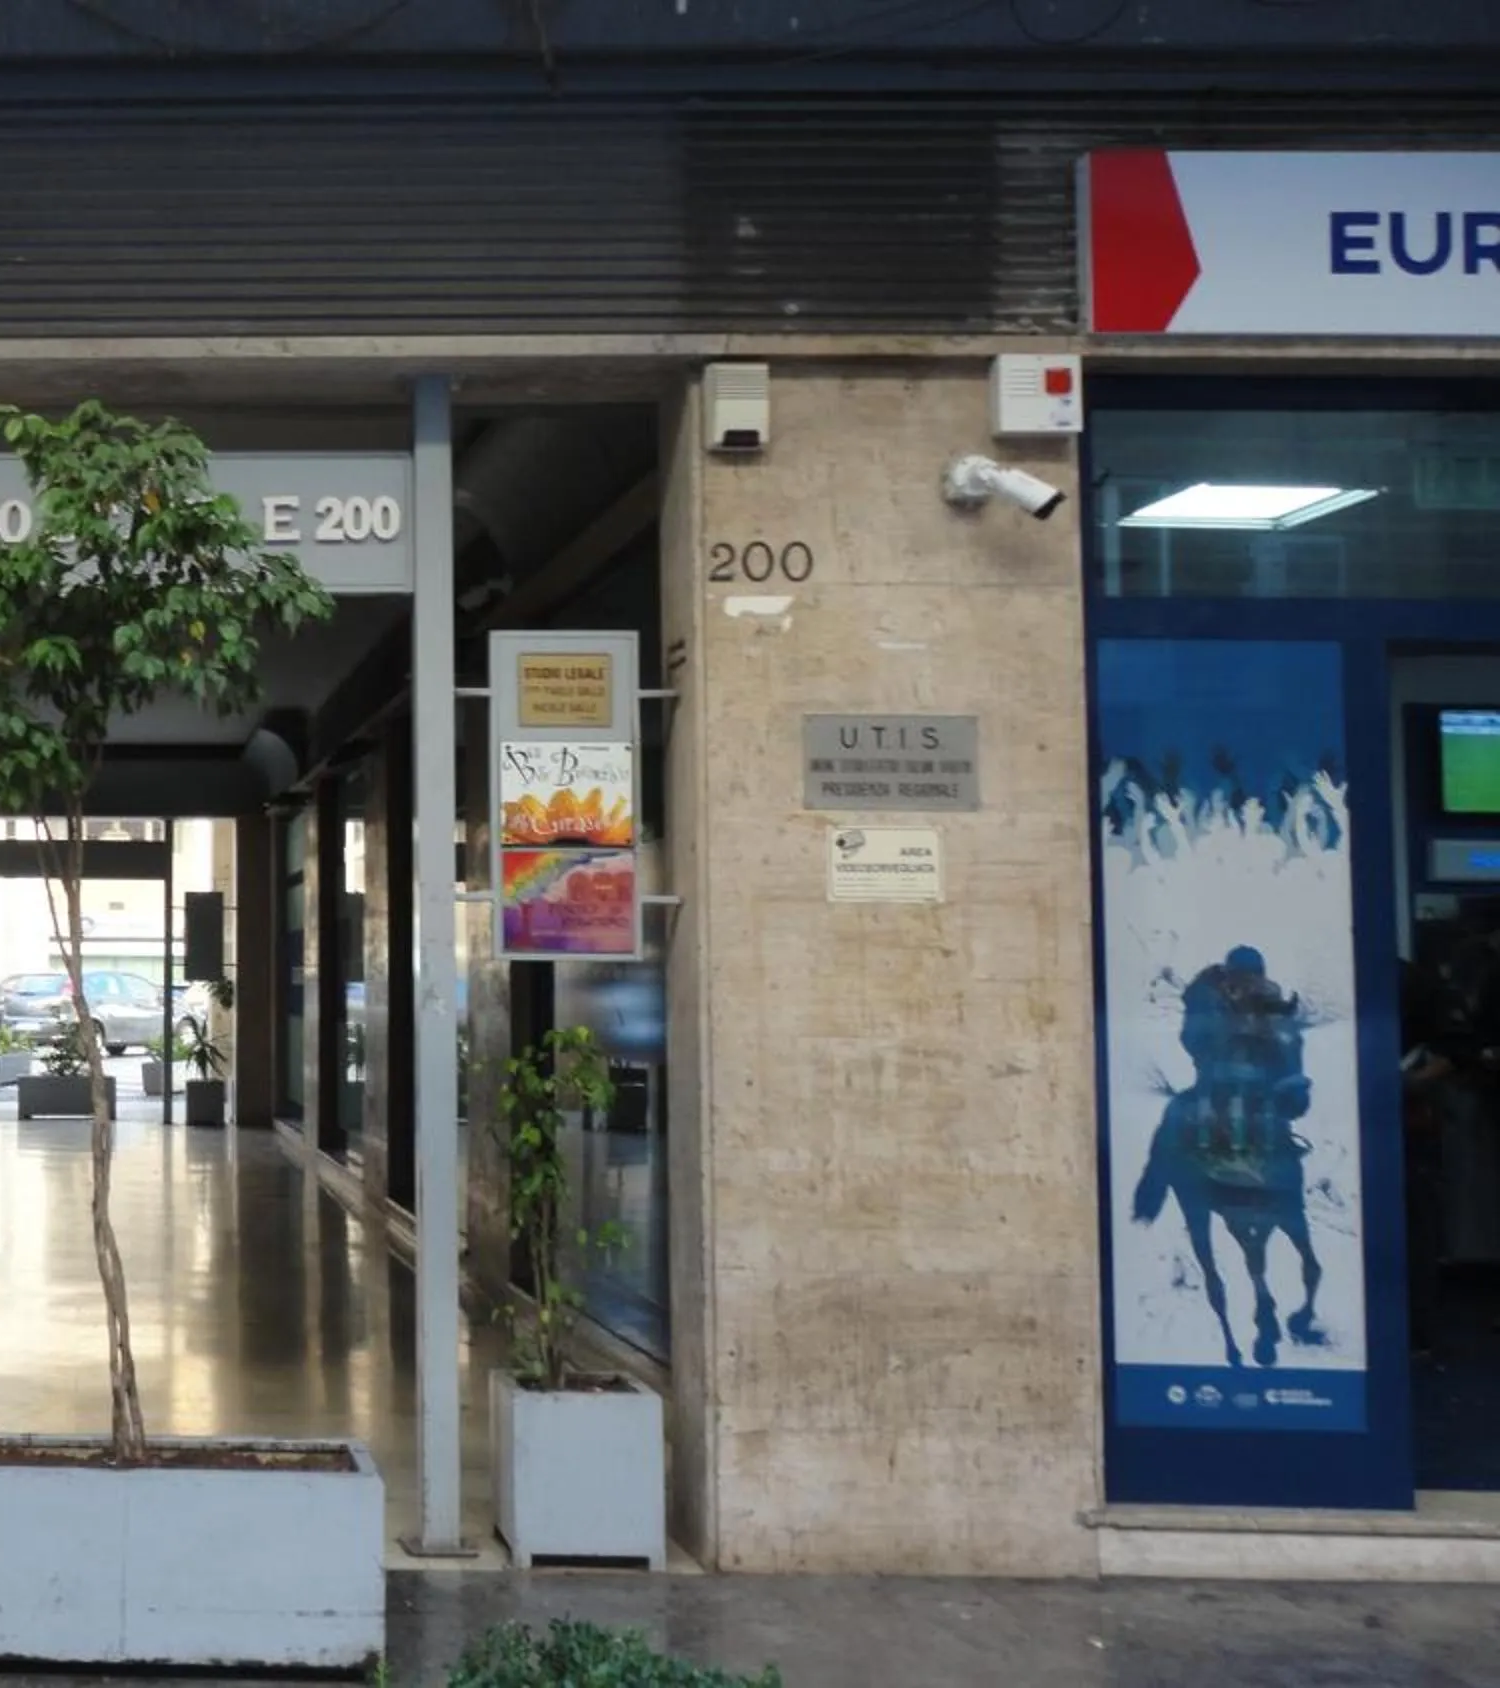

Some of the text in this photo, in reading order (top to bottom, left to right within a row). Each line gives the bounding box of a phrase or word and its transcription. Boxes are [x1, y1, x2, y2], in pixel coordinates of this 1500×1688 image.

[1330, 211, 1500, 275] EUR
[315, 496, 400, 541] 200
[708, 541, 814, 583] 200
